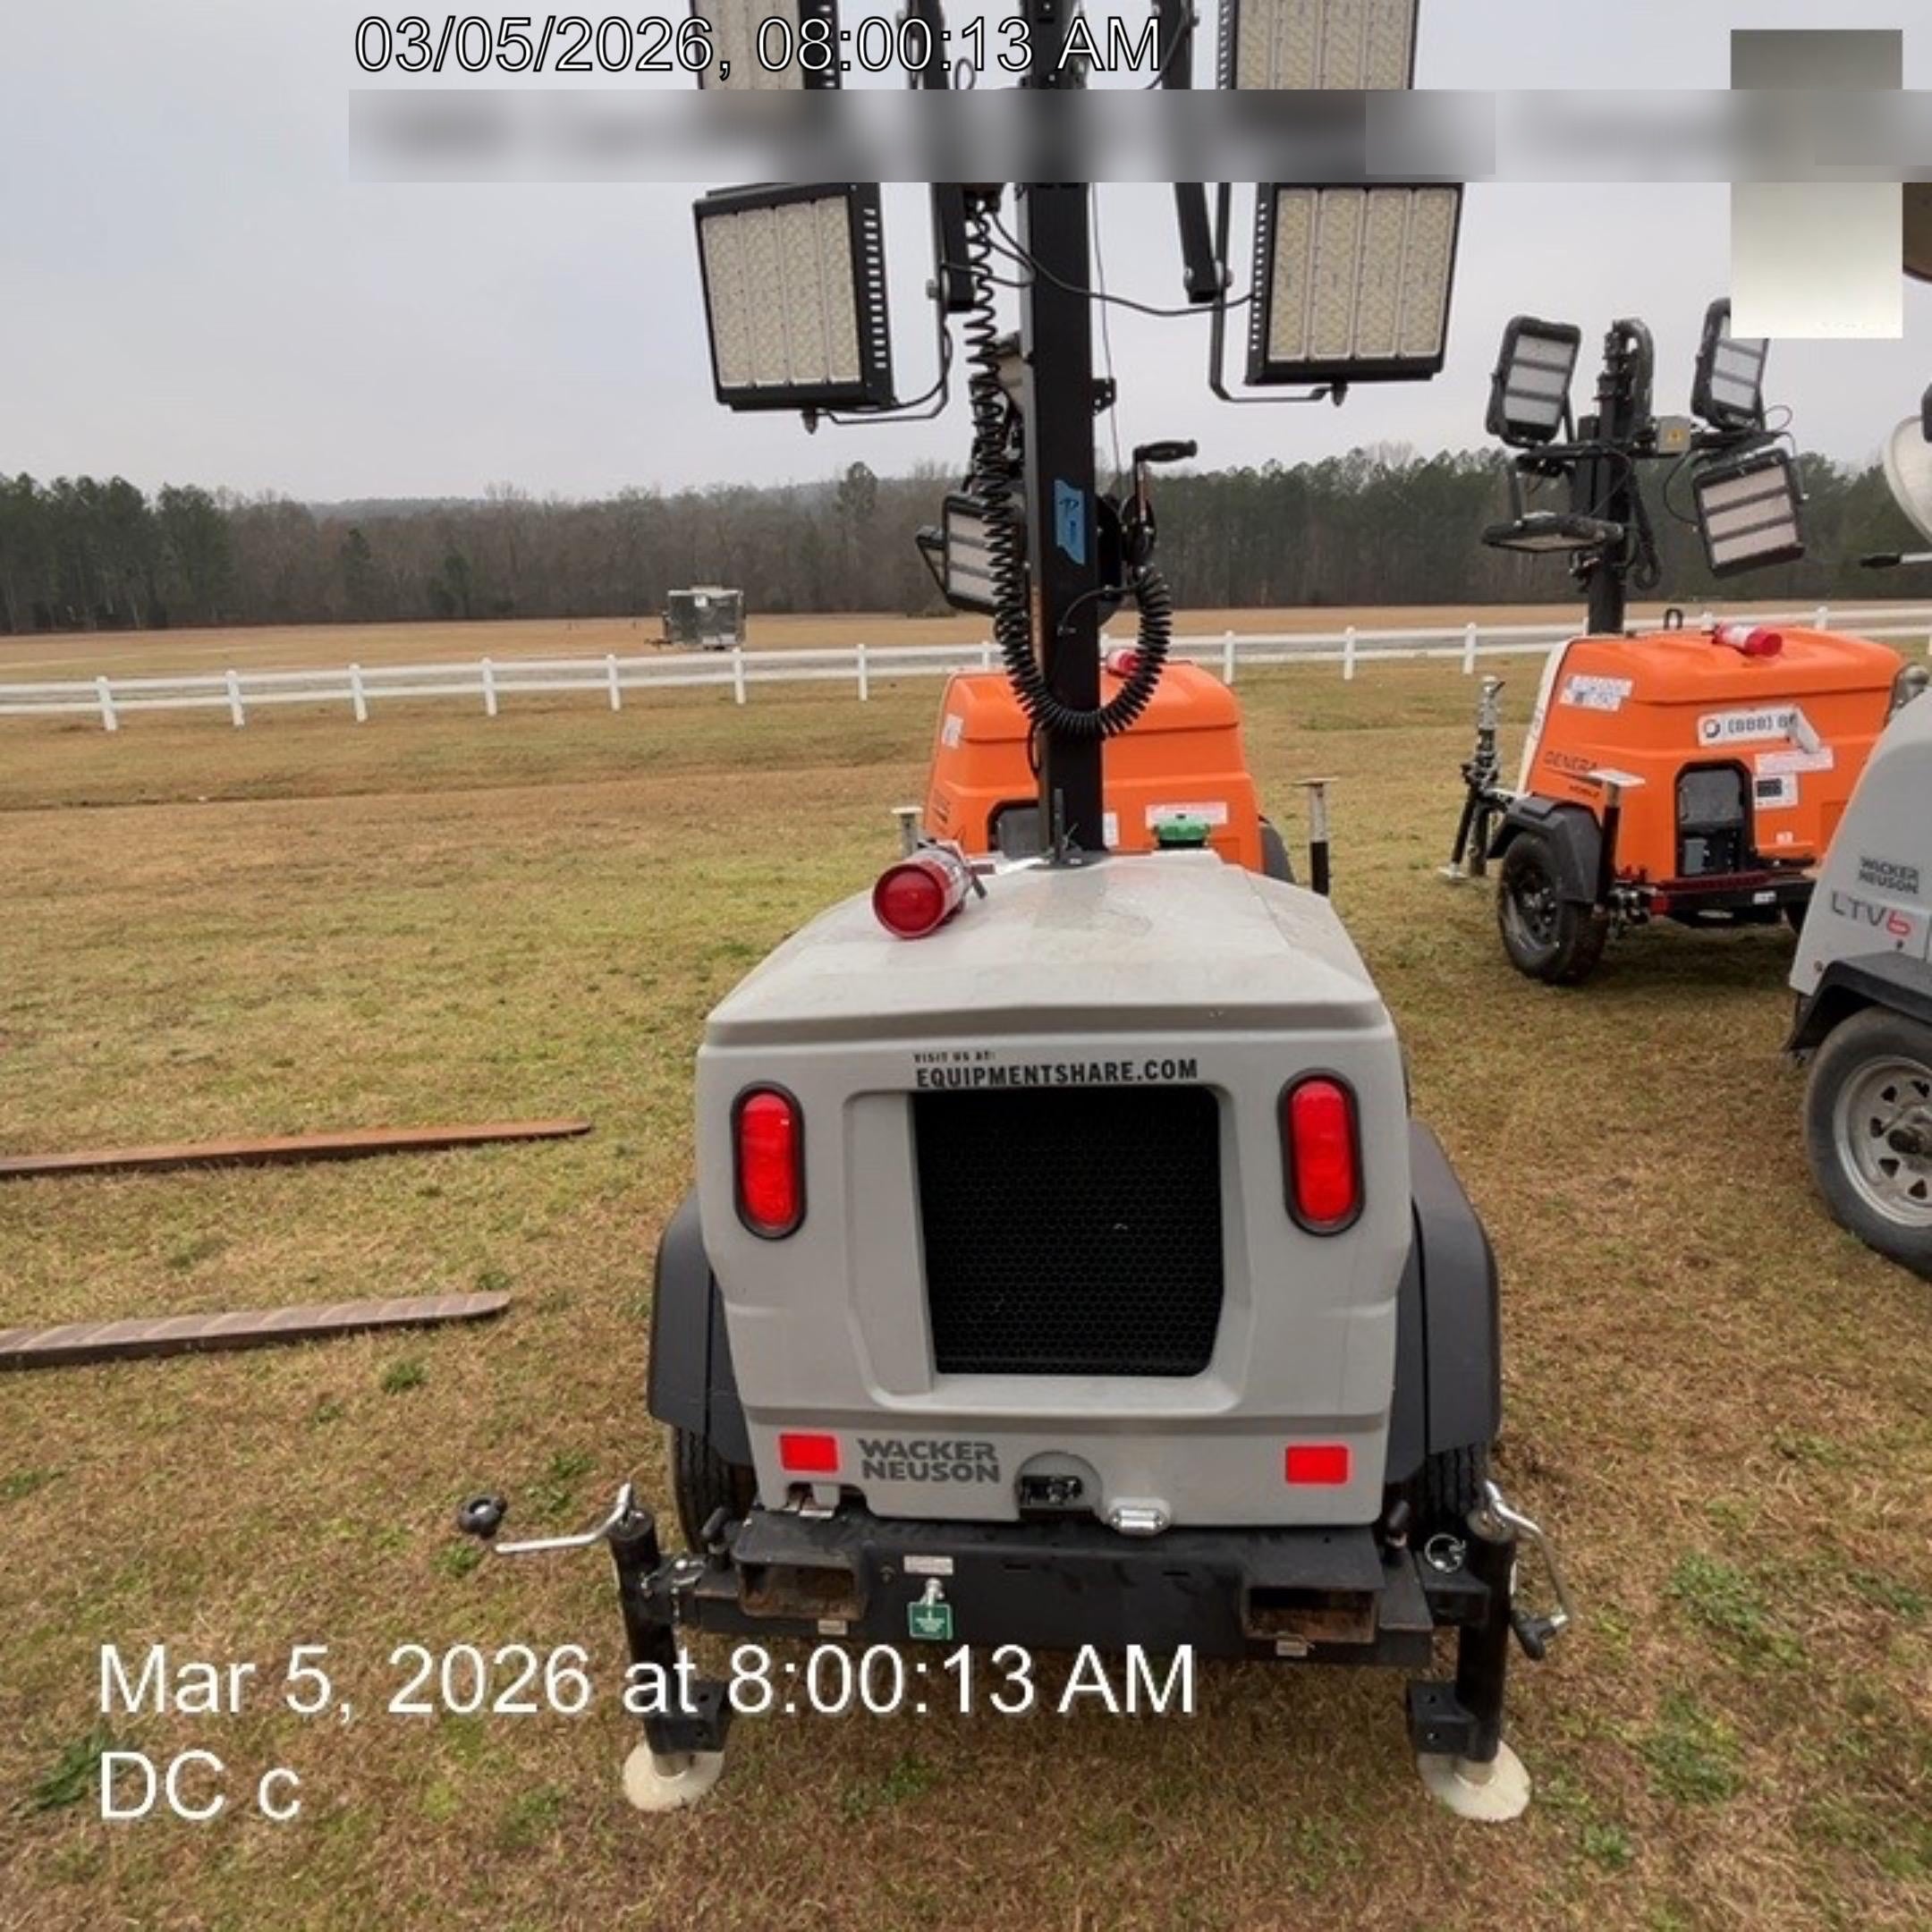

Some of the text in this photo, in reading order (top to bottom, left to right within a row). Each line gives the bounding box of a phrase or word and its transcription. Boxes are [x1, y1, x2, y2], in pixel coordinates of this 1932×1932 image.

[1831, 891, 1911, 937] LTV6
[917, 1058, 1198, 1089] EQUIPMENTSHARE.COM
[857, 1437, 998, 1462] WACKER
[862, 1460, 1000, 1483] NEUSON
